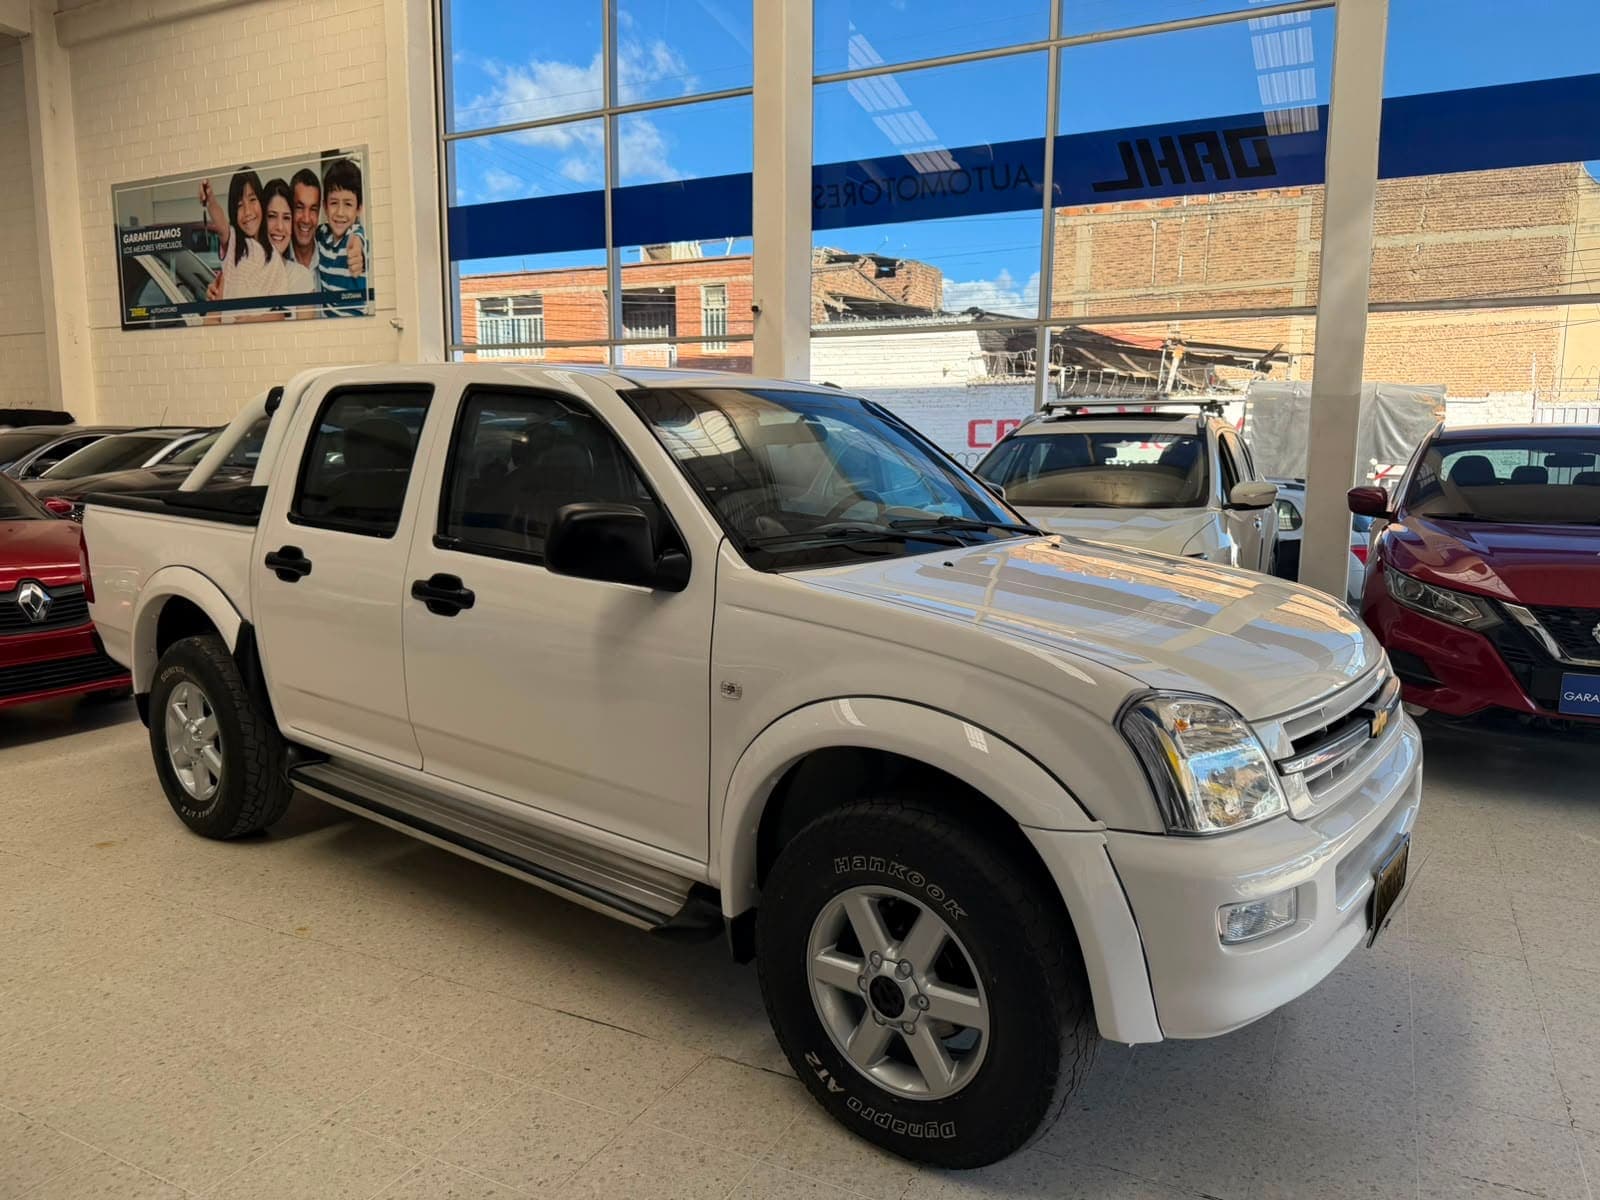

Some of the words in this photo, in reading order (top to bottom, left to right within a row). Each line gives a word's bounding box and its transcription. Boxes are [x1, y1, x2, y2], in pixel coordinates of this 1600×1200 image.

[122, 227, 182, 244] GARANTIZAMOS
[1563, 691, 1600, 703] GARA
[846, 1096, 957, 1139] Dynapro
